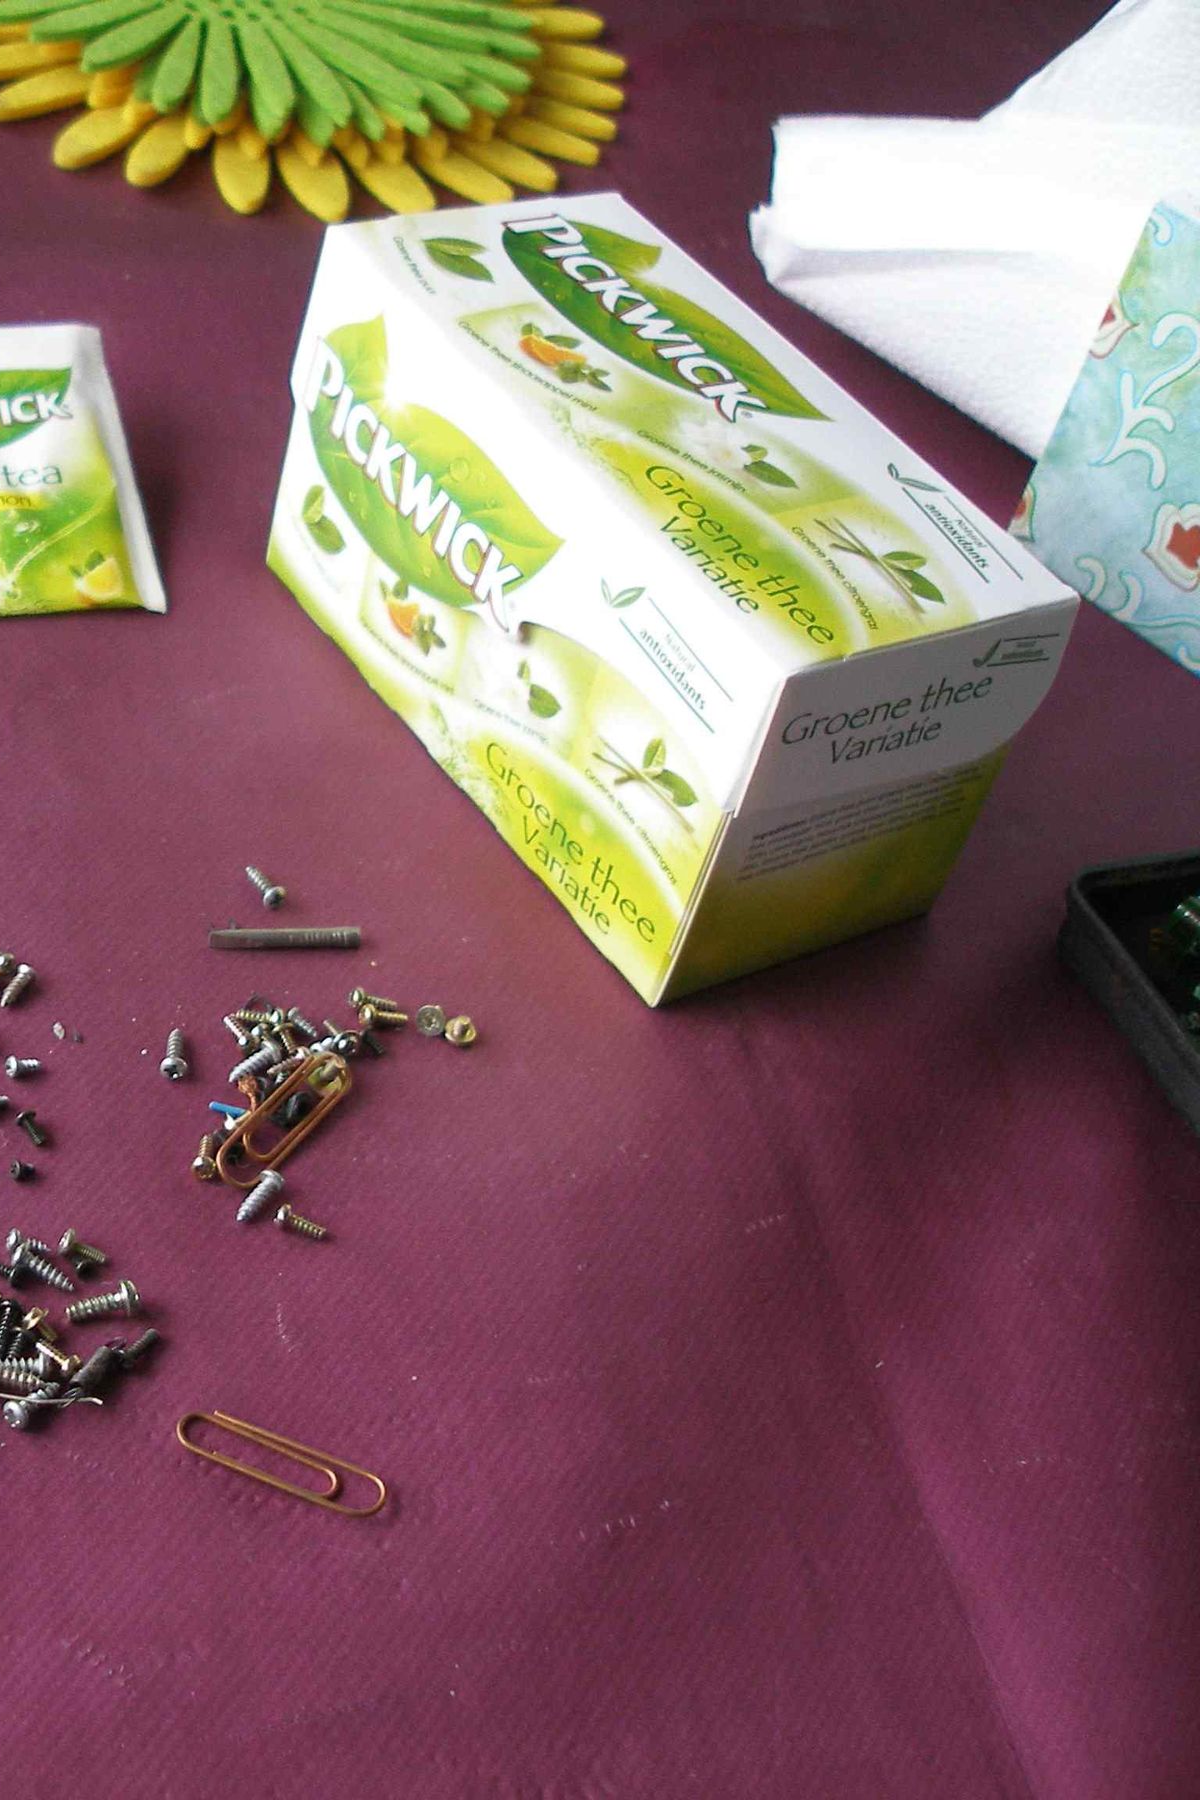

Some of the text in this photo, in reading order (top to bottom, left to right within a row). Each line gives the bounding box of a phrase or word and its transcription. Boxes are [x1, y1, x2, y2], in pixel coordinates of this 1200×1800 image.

[503, 214, 768, 423] PICKWICK
[3, 464, 63, 488] tea
[303, 335, 524, 633] PICKWICK
[681, 452, 709, 469] thee
[645, 465, 836, 645] Groene thee
[660, 514, 759, 615] Variatie
[925, 504, 989, 568] antioxidants
[639, 629, 705, 710] antioxidants
[781, 676, 993, 746] Groene thee
[831, 717, 942, 765] Variatie
[486, 742, 656, 943] Groene thee
[522, 815, 612, 935] Variatie
